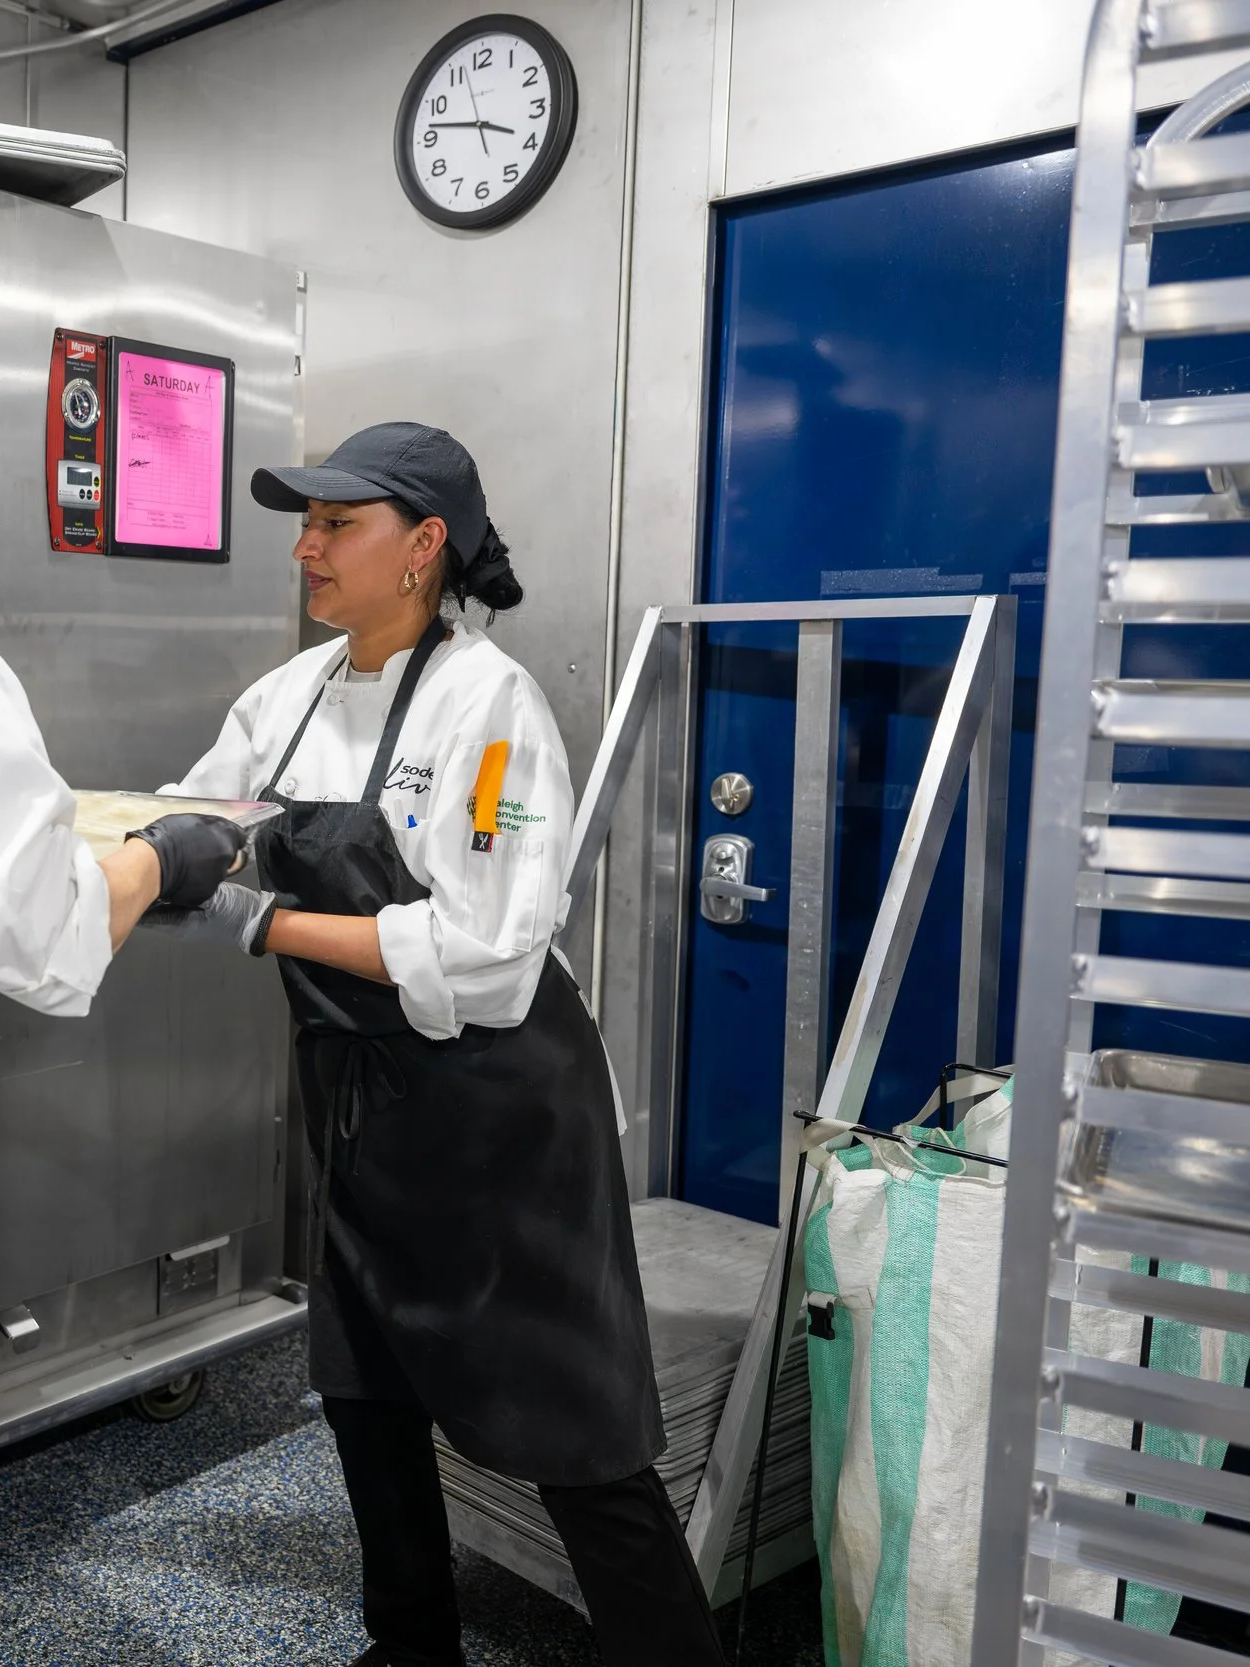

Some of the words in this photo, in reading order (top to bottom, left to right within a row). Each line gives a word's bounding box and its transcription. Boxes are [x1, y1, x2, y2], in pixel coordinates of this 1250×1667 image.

[473, 48, 493, 71] 12
[509, 49, 514, 69] 1
[450, 66, 463, 87] 11
[522, 66, 538, 88] 2
[431, 95, 447, 116] 10
[528, 97, 546, 119] 3
[423, 130, 438, 148] 9
[522, 131, 538, 151] 4
[431, 159, 447, 177] 8
[502, 163, 519, 183] 5
[450, 177, 464, 197] 7
[474, 181, 490, 200] 6
[71, 341, 95, 354] METRO
[143, 372, 200, 394] SATURDAY
[400, 765, 434, 780] sode
[497, 798, 524, 813] aleigh
[495, 809, 546, 823] onvention
[495, 821, 522, 832] enter
